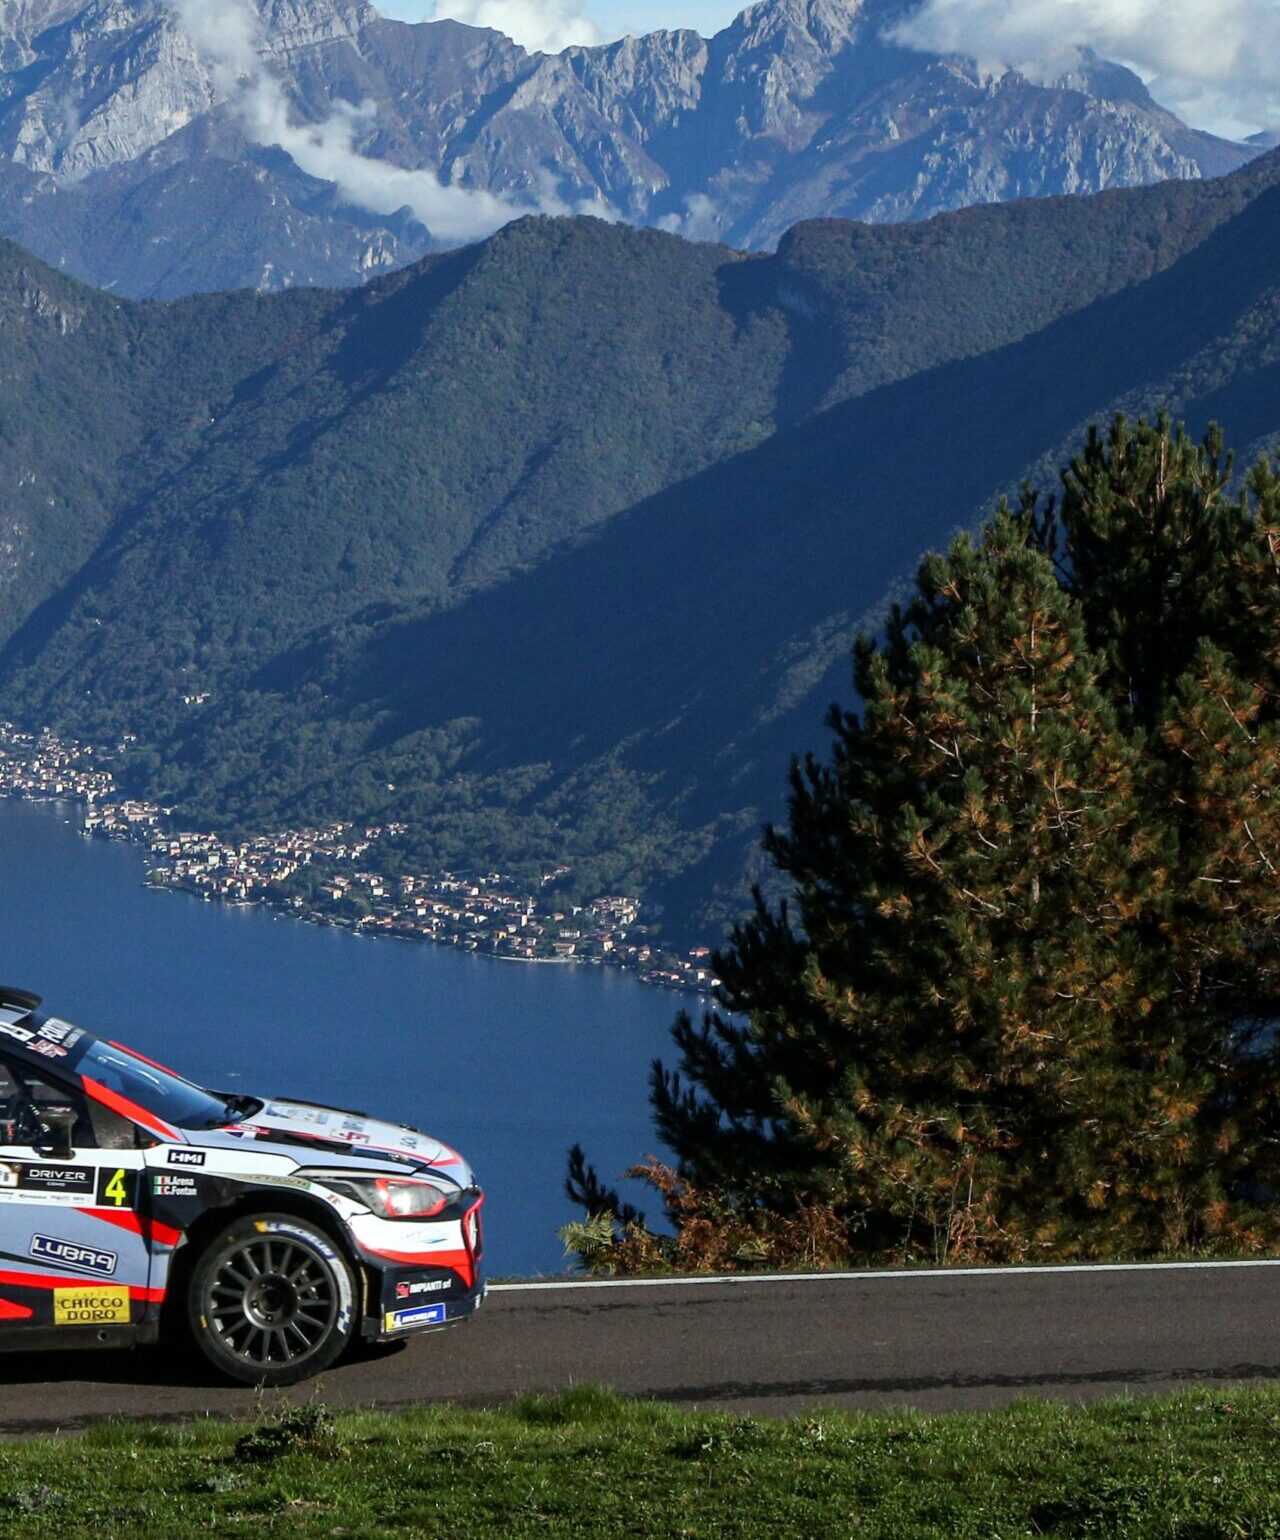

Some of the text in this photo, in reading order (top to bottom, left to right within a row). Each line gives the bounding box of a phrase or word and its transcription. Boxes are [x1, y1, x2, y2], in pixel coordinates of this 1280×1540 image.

[170, 1152, 203, 1164] HMI
[29, 1169, 86, 1180] DRIVER
[105, 1169, 126, 1206] 4
[33, 1239, 113, 1270] LUBRA
[61, 1297, 123, 1309] CHICCO
